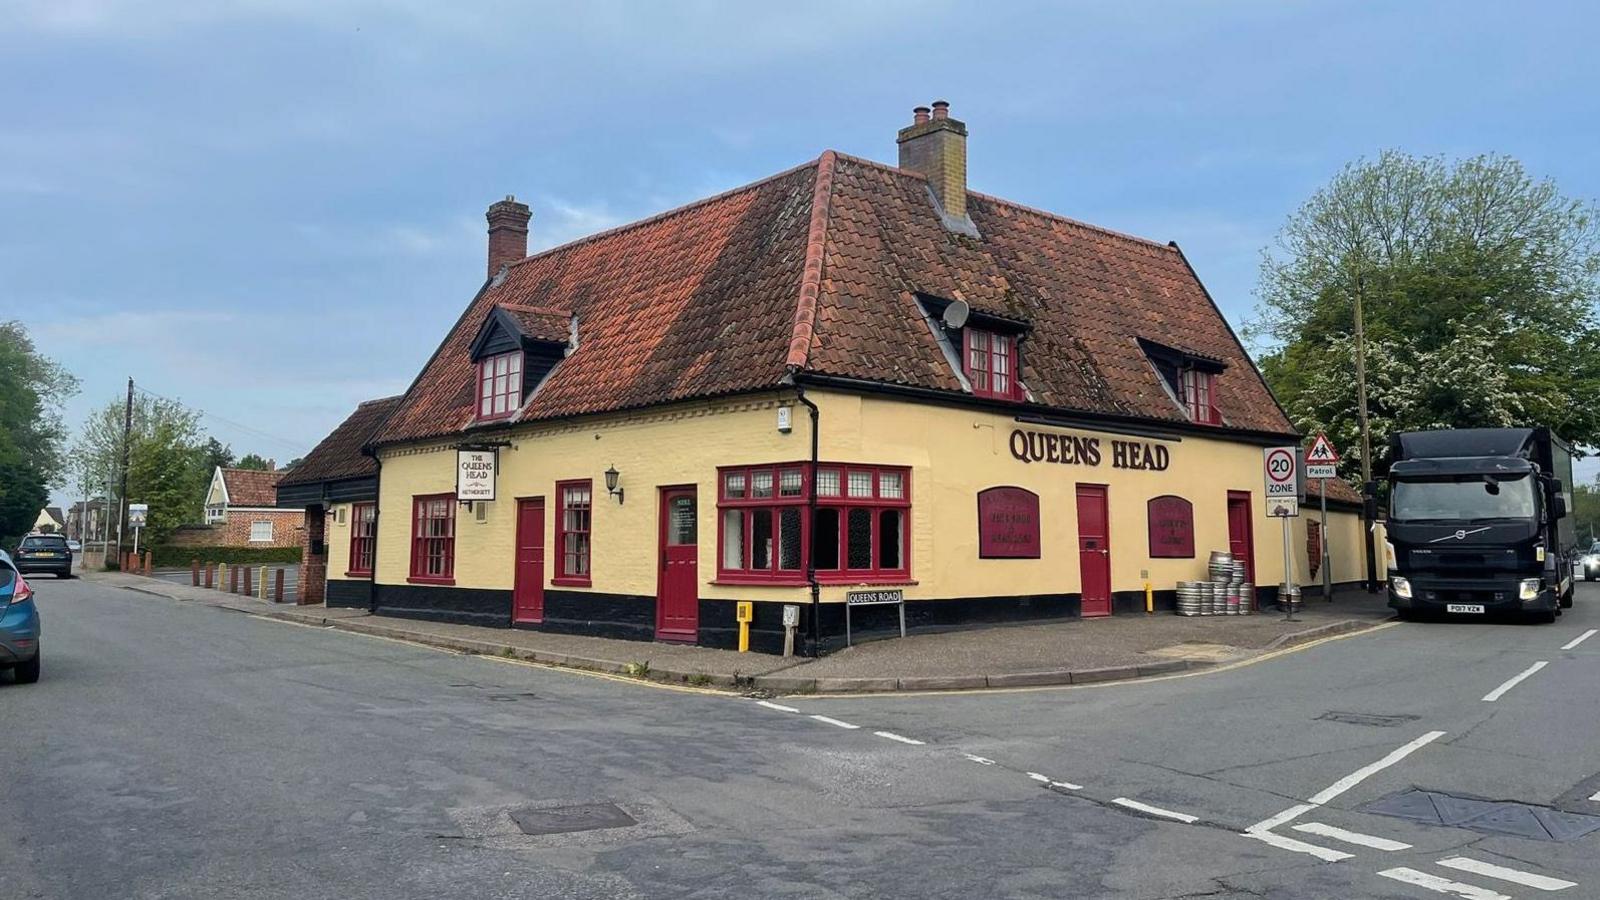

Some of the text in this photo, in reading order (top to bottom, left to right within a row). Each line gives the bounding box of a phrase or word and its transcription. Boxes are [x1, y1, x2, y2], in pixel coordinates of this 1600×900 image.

[1009, 428, 1170, 471] QUEENS HEAD
[461, 462, 492, 470] QUEENS
[1271, 459, 1289, 473] 20
[465, 471, 488, 479] HEAD
[1309, 467, 1333, 475] Patrol
[1269, 484, 1293, 493] ZONE
[850, 592, 898, 602] QUEENS ROAD
